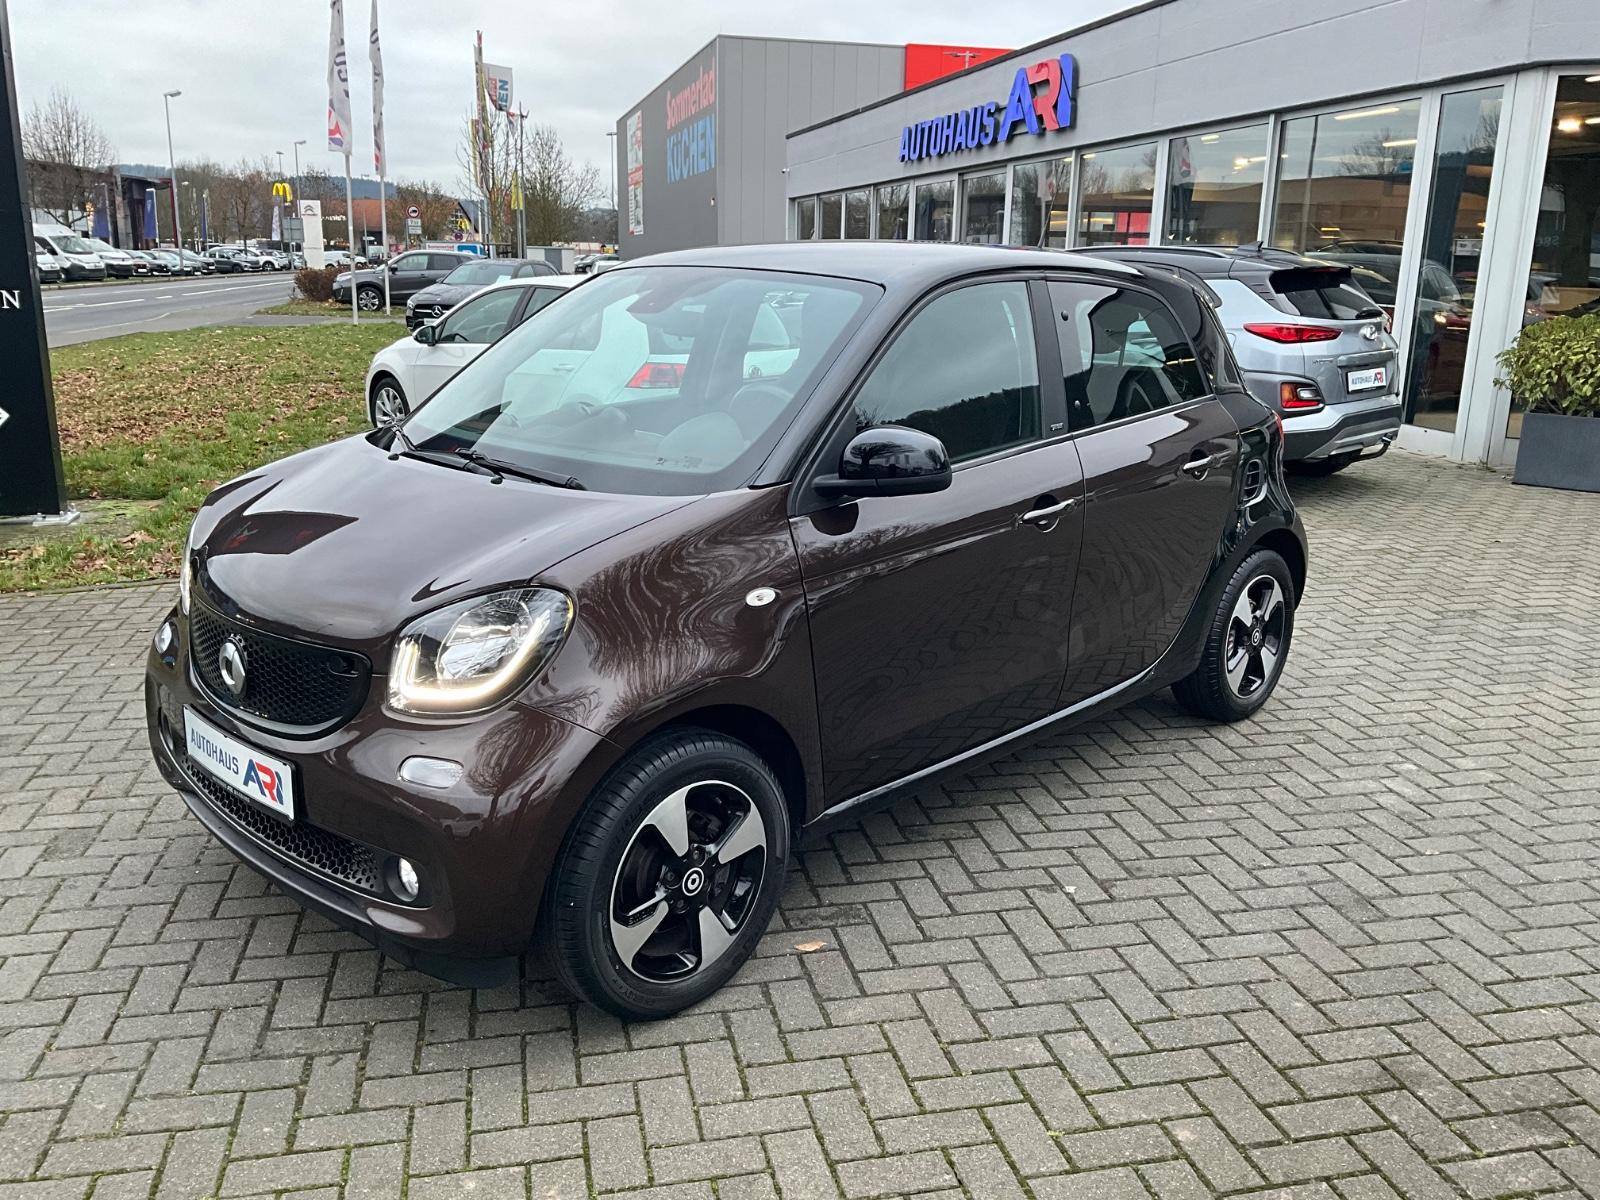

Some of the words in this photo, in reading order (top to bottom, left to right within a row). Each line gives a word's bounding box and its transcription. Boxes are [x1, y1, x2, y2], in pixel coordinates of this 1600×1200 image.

[666, 56, 715, 131] Sommerlad
[900, 102, 997, 162] AUTOHAUS
[998, 53, 1077, 142] ARI
[666, 113, 715, 185] KÜCHEN
[1351, 375, 1373, 386] AUTOHAUS
[190, 727, 240, 776] AUTOHAUS
[243, 758, 285, 806] ARI
